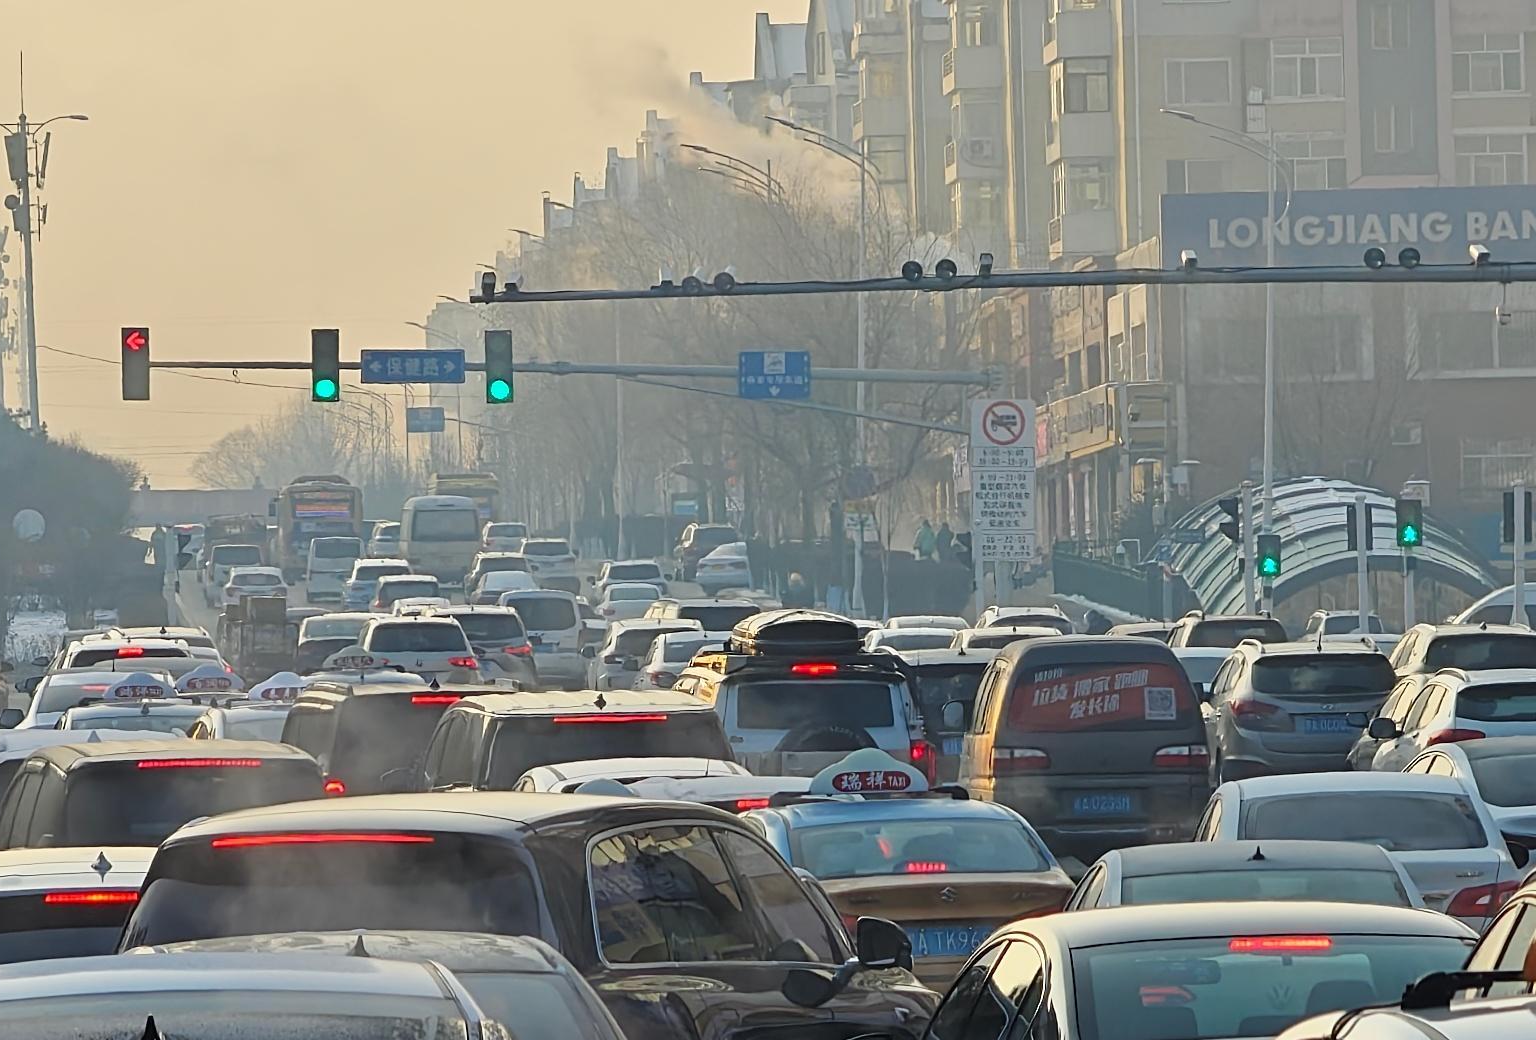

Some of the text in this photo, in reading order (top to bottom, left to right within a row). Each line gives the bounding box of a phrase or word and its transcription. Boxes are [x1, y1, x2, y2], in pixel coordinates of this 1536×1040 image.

[1208, 211, 1452, 249] LONGJIANG
[841, 771, 907, 791] 瑞祥 TAXI
